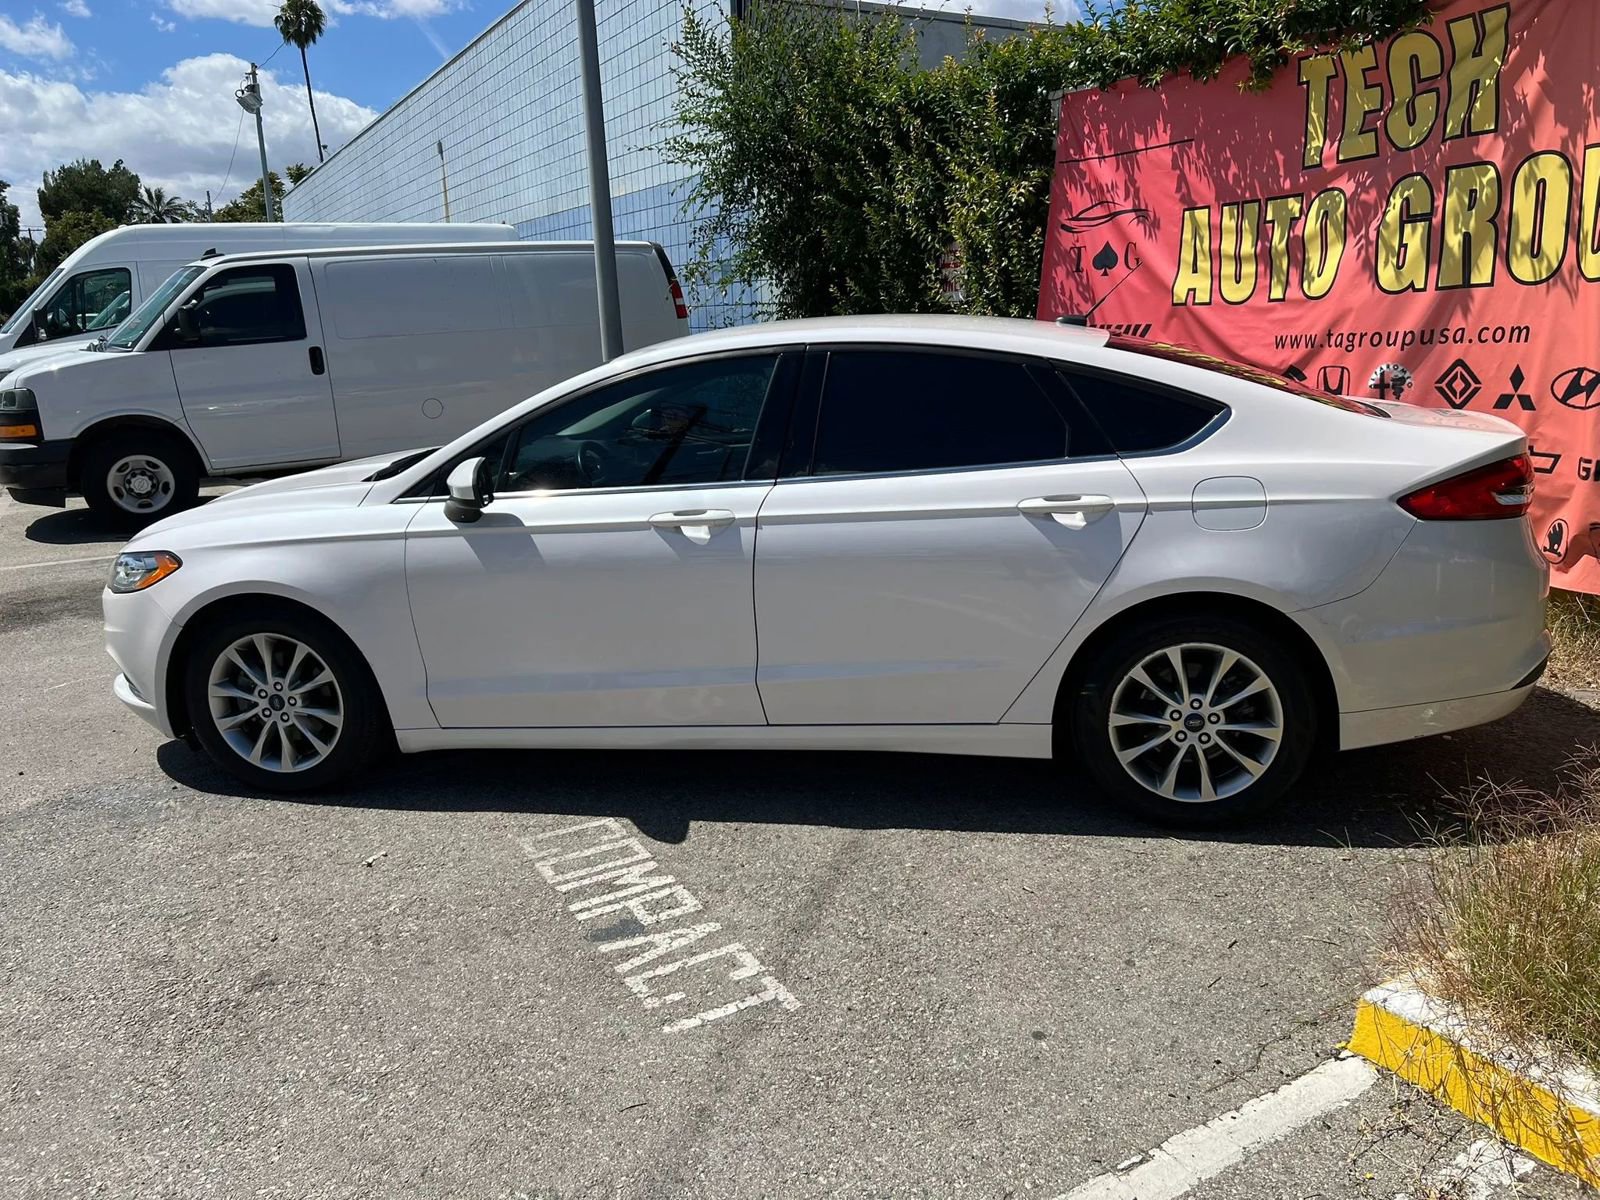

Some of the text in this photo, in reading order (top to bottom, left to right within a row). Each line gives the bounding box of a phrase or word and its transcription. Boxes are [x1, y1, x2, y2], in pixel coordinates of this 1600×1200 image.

[1297, 2, 1510, 171] TECH
[1172, 186, 1346, 306] AUTO
[1274, 324, 1531, 352] www.tagroupusa.com
[520, 817, 803, 1033] COMPACT
